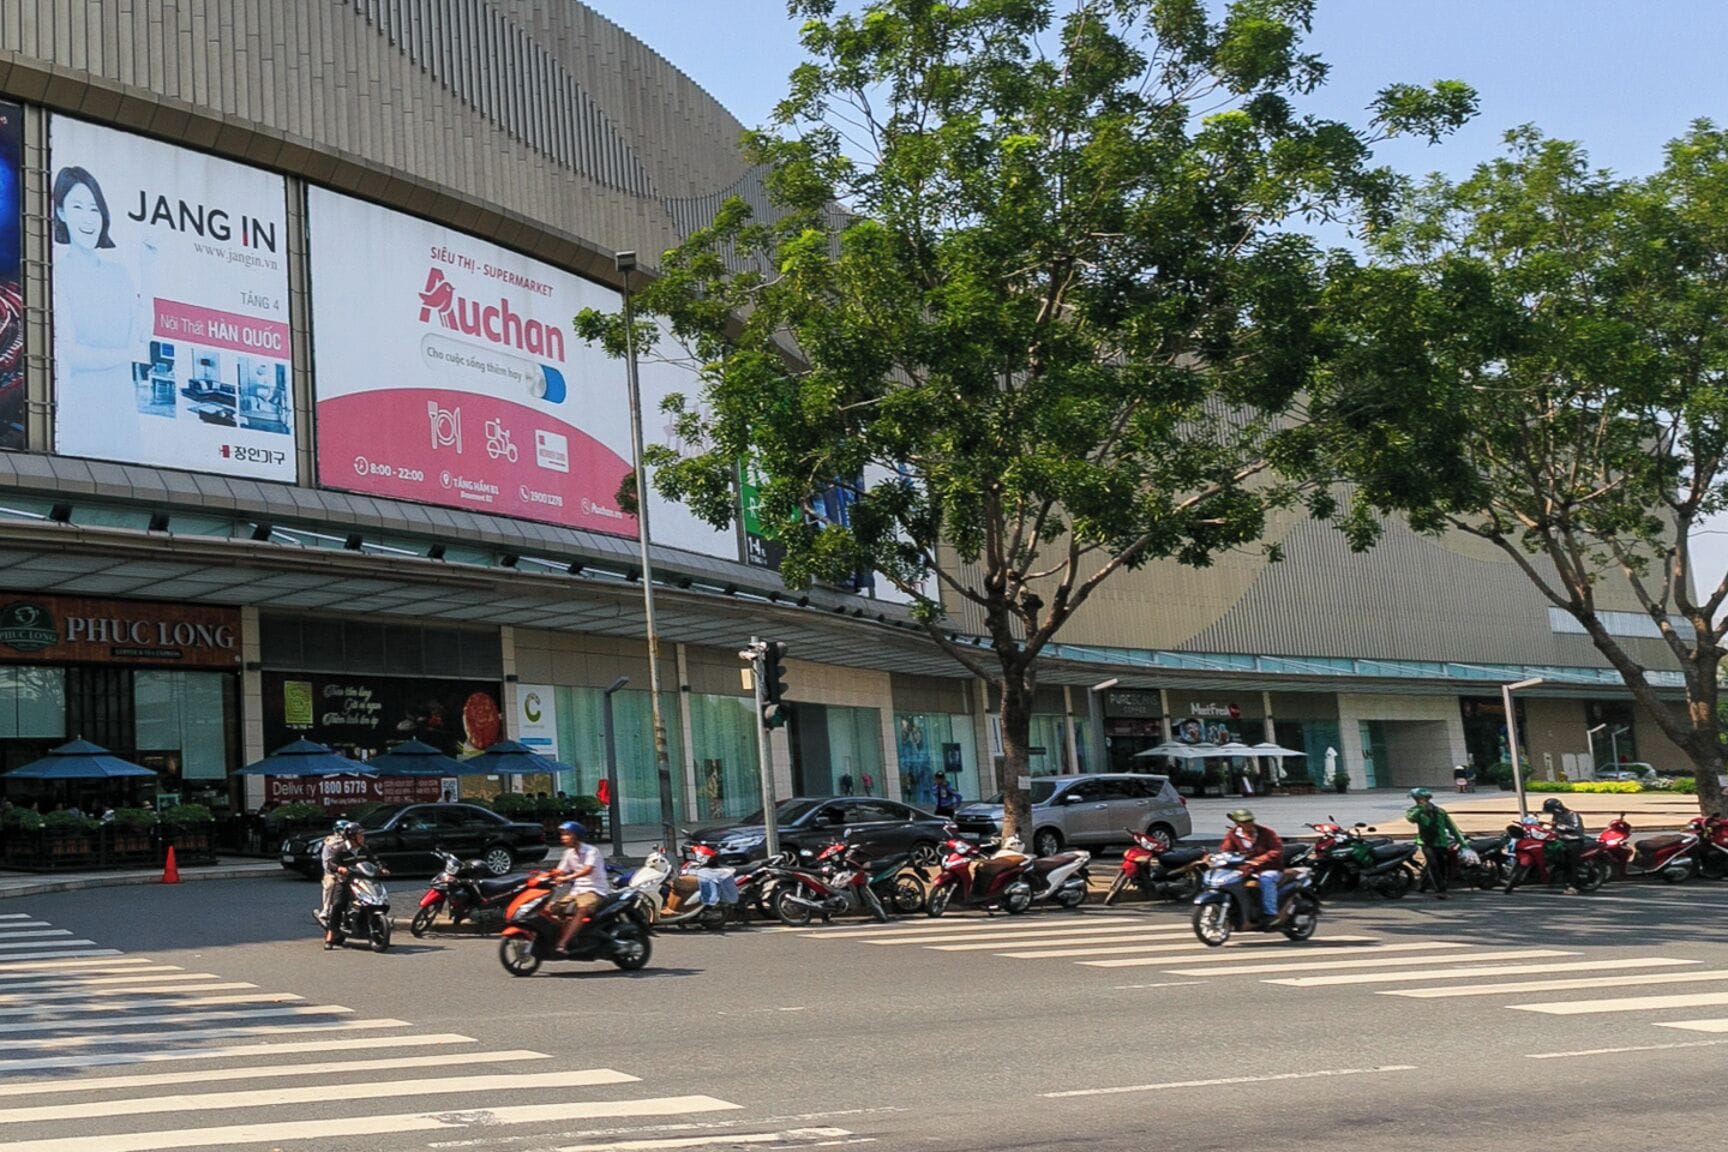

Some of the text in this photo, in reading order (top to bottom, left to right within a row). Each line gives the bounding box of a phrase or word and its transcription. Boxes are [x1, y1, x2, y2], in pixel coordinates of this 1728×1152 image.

[128, 190, 276, 253] JANG IN
[193, 242, 278, 271] www.jangin.vn
[430, 246, 455, 264] SIÊU
[458, 254, 475, 274] THỊ
[483, 263, 554, 298] SUPERMARKET
[273, 299, 280, 311] 4
[418, 267, 566, 363] Auchan
[207, 318, 239, 342] HÀN
[242, 324, 282, 351] QUỐC
[426, 346, 444, 360] Cho
[370, 463, 392, 476] 8:00
[398, 467, 424, 482] 22:00
[66, 616, 235, 649] PHUC LONG
[319, 780, 342, 794] 1800
[344, 780, 368, 794] 6779
